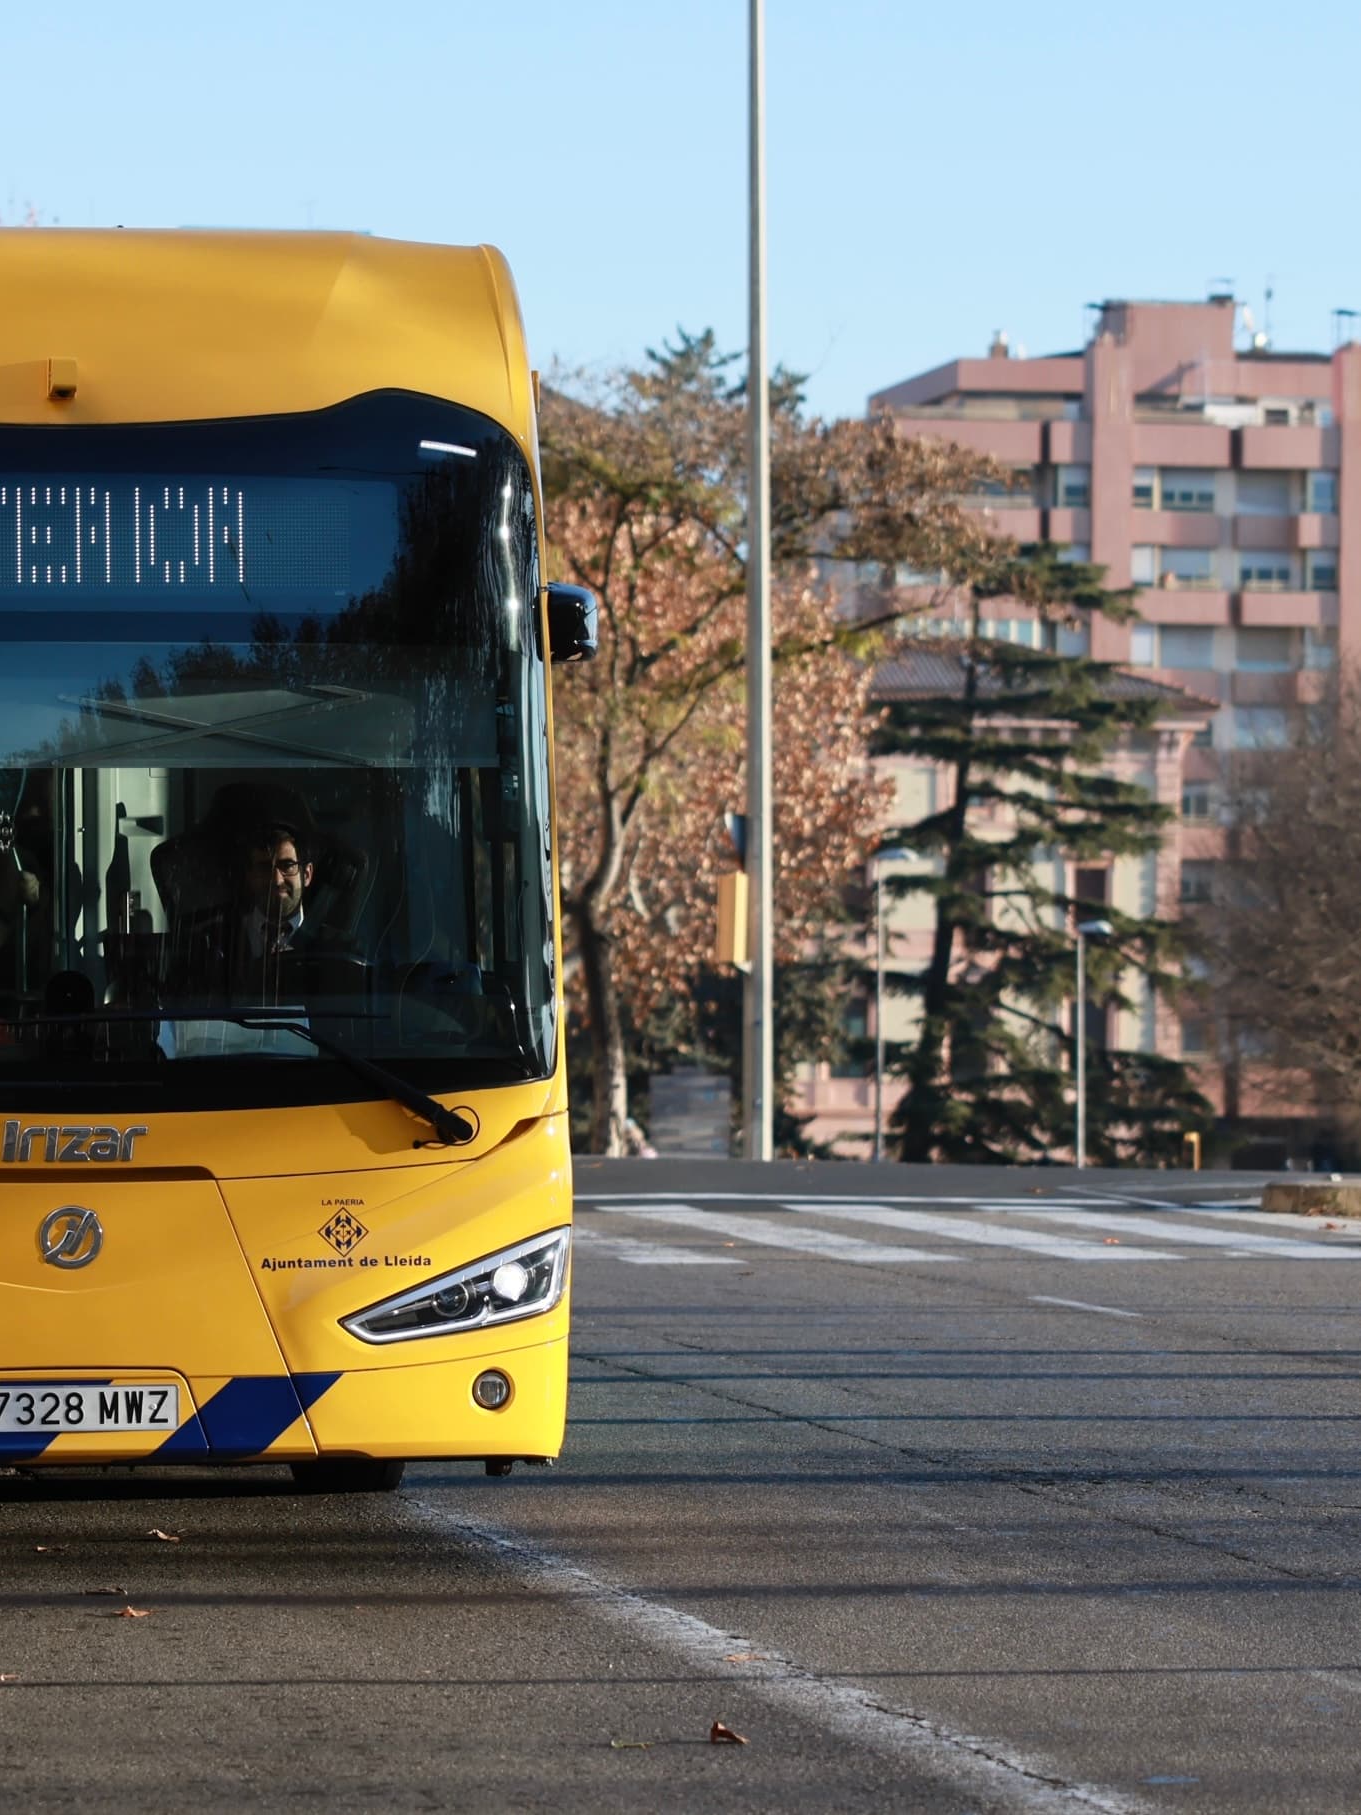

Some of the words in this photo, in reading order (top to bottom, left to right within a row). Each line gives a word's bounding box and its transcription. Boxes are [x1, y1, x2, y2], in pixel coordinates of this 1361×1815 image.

[2, 1120, 149, 1162] Irizar
[321, 1198, 333, 1207] LA
[334, 1198, 365, 1207] PAERIA
[261, 1256, 354, 1272] Ajuntament
[359, 1256, 379, 1268] de
[384, 1255, 432, 1267] Lleida
[99, 1390, 169, 1425] MWZ
